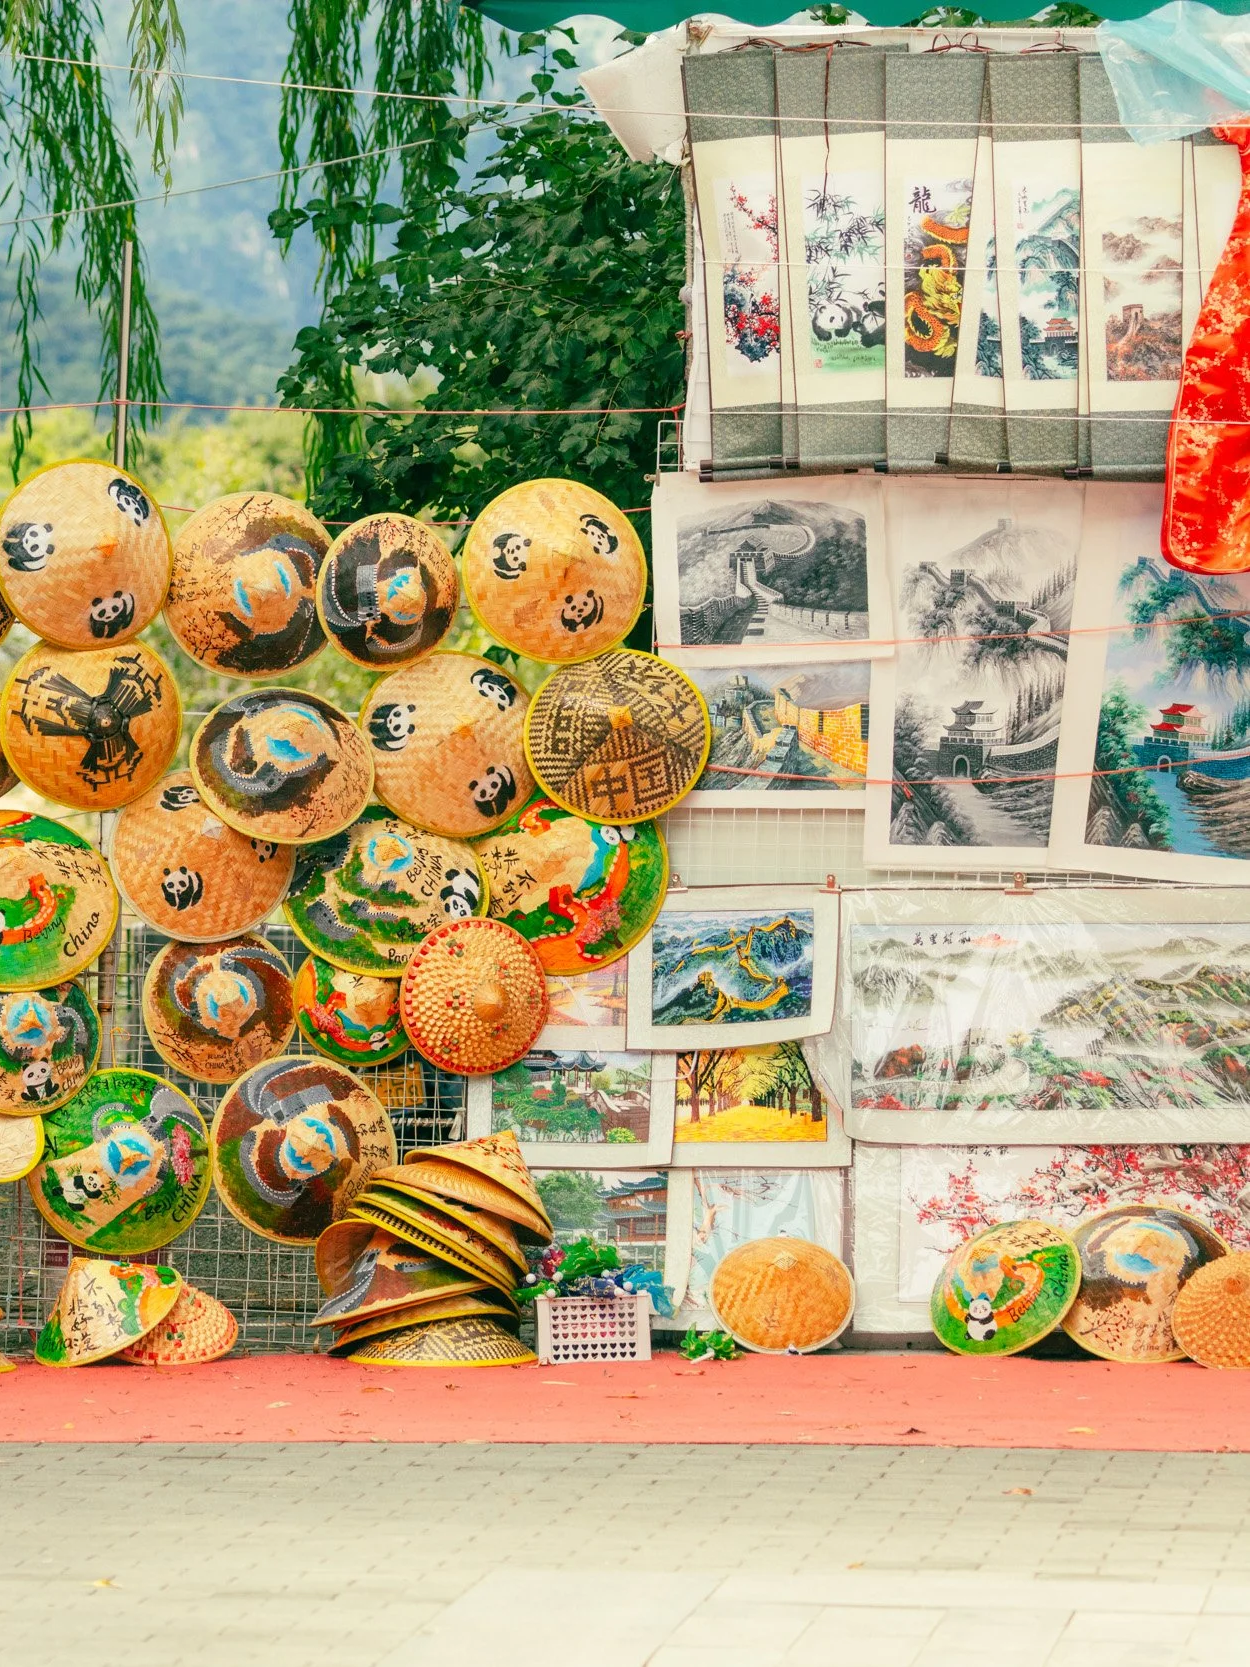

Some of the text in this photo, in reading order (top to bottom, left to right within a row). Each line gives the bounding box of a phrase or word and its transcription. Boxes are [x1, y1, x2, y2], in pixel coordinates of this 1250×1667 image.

[908, 186, 937, 214] 龍
[420, 854, 443, 897] CHINA
[23, 916, 67, 944] Beijing
[63, 911, 100, 958] China
[171, 1173, 203, 1224] CHINA
[1053, 1253, 1070, 1298] China
